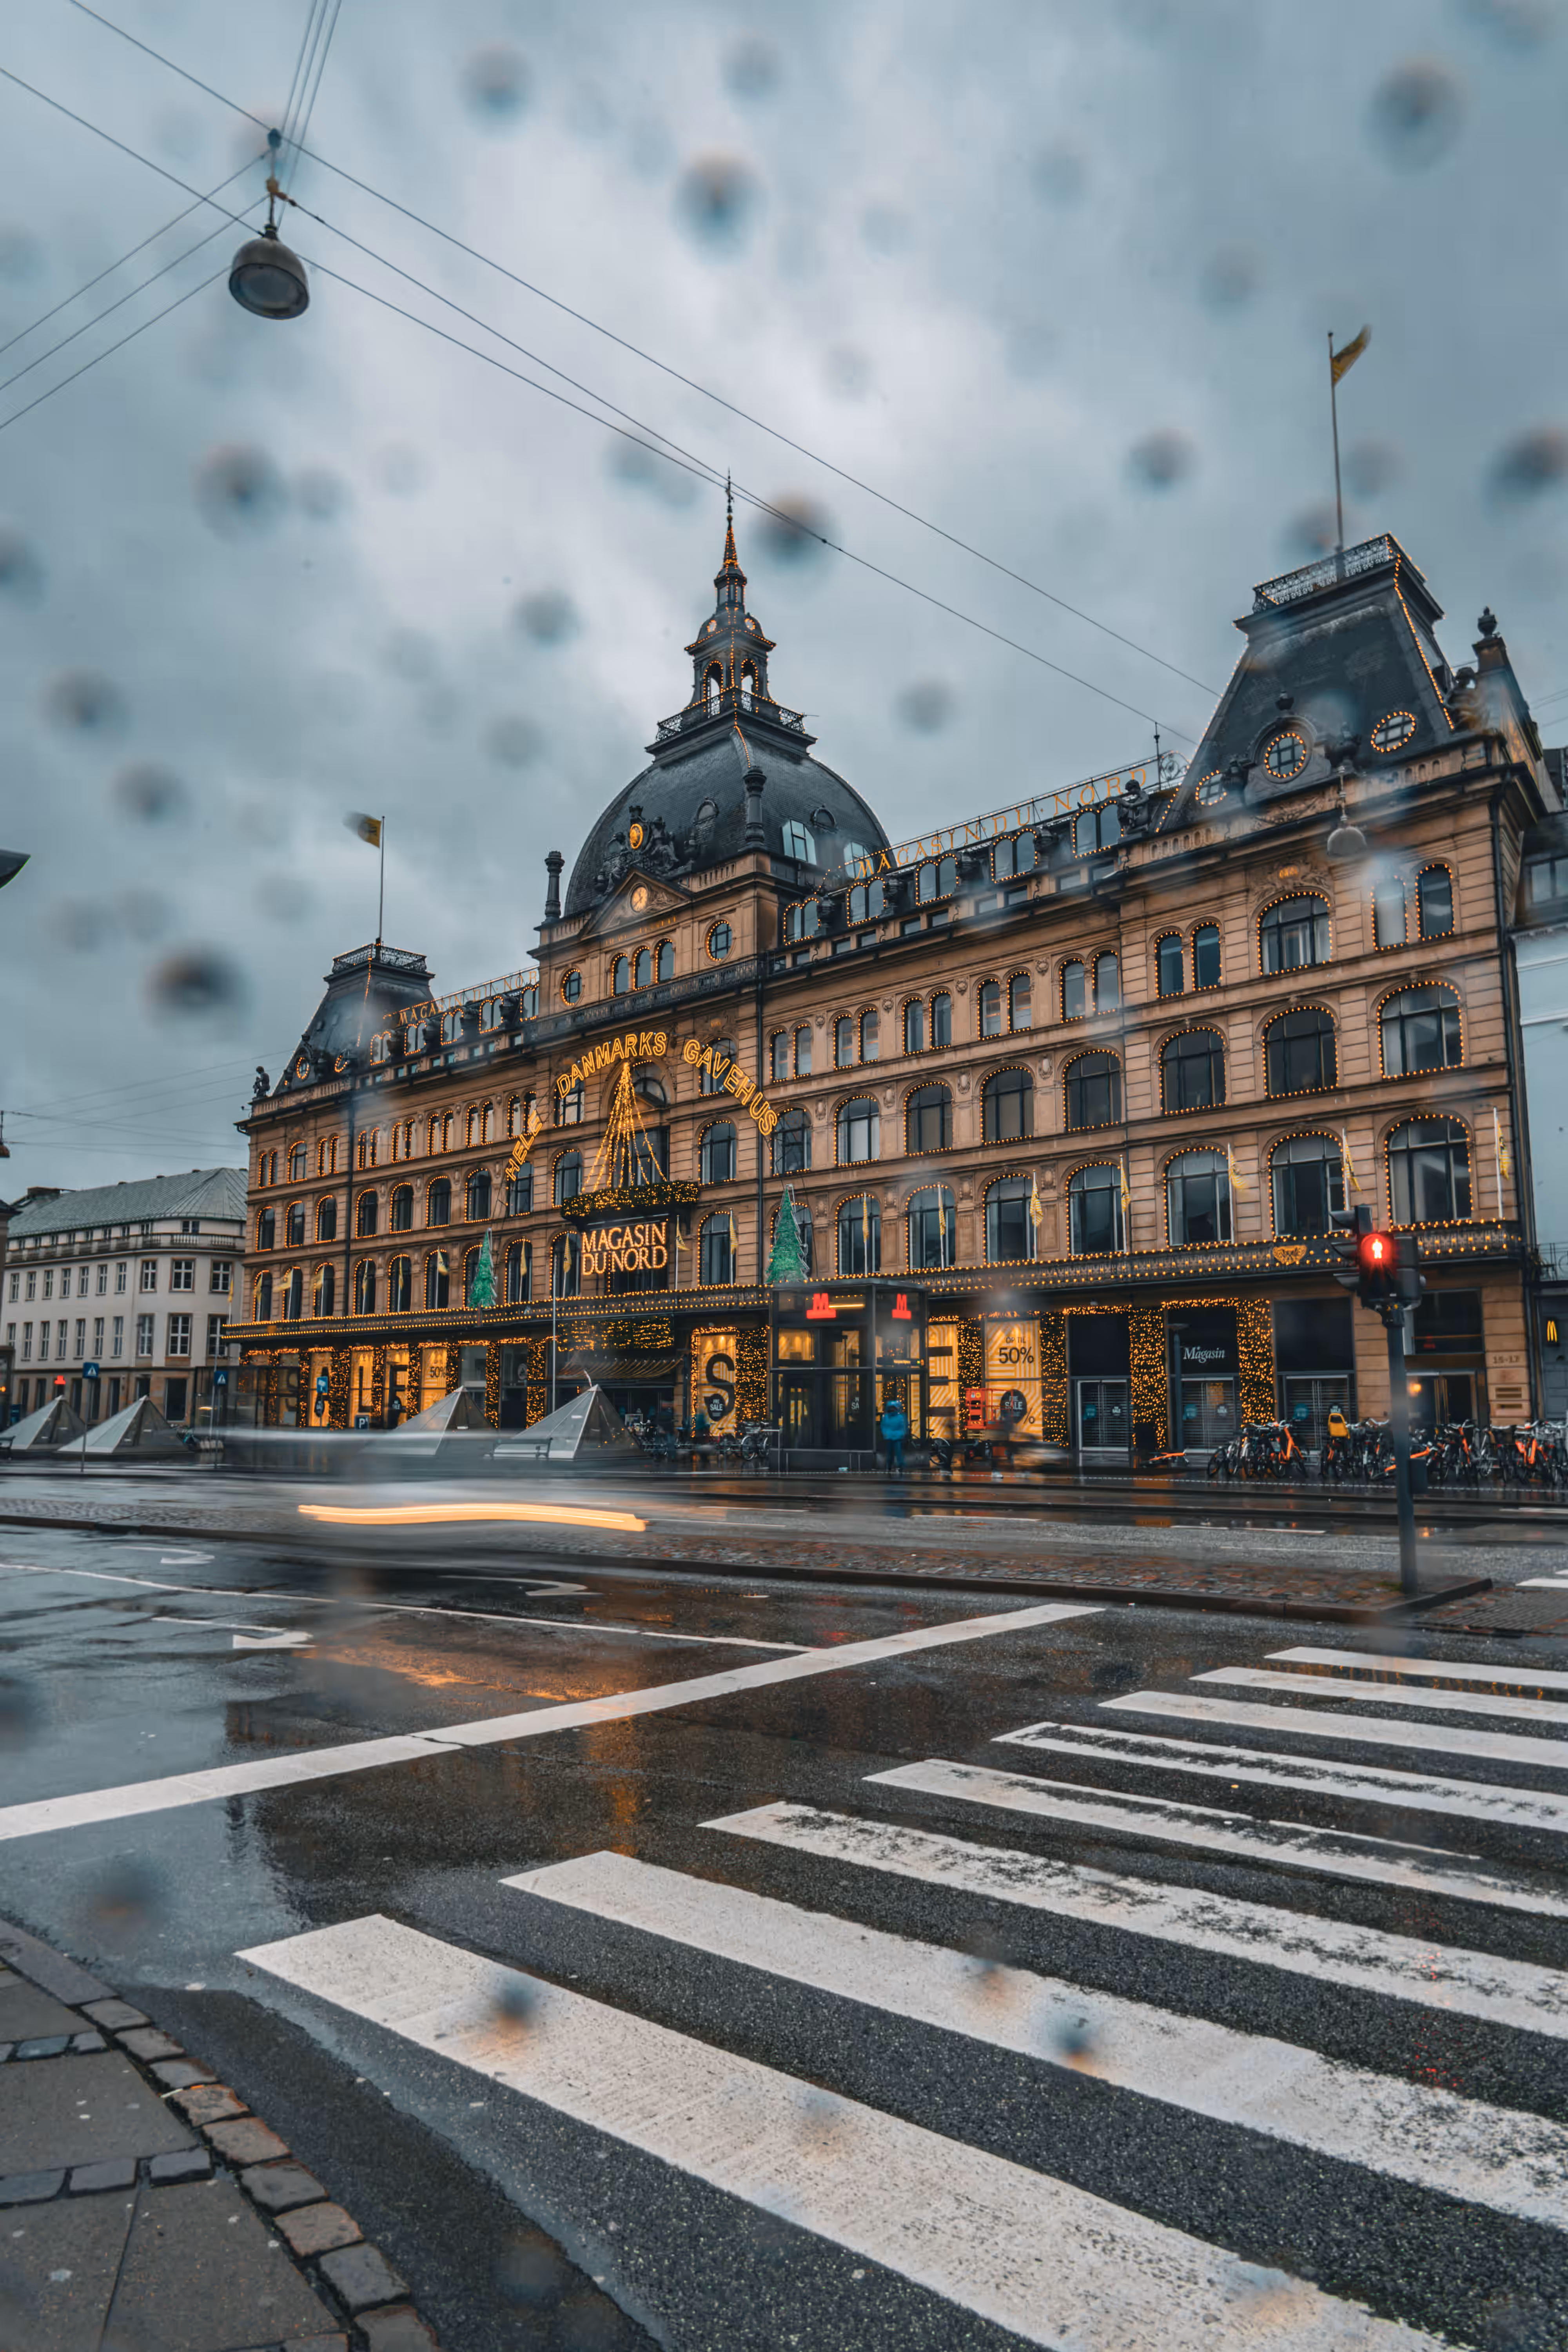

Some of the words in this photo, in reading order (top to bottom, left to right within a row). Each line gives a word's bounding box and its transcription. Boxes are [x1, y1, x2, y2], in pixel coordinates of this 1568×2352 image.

[855, 822, 980, 880] MAGASIN
[992, 806, 1030, 836] DU
[1054, 768, 1146, 816] NORD
[504, 971, 536, 990] NOR
[505, 1110, 543, 1182] HELE
[556, 1032, 667, 1098] DANMARKS
[684, 1039, 778, 1136] GAVEHUS
[582, 1221, 666, 1253] MAGASIN
[582, 1253, 607, 1275] DU
[611, 1246, 668, 1271] NORD
[999, 1346, 1034, 1364] 50%
[1183, 1346, 1225, 1363] Magasin
[1005, 1401, 1023, 1410] SALE
